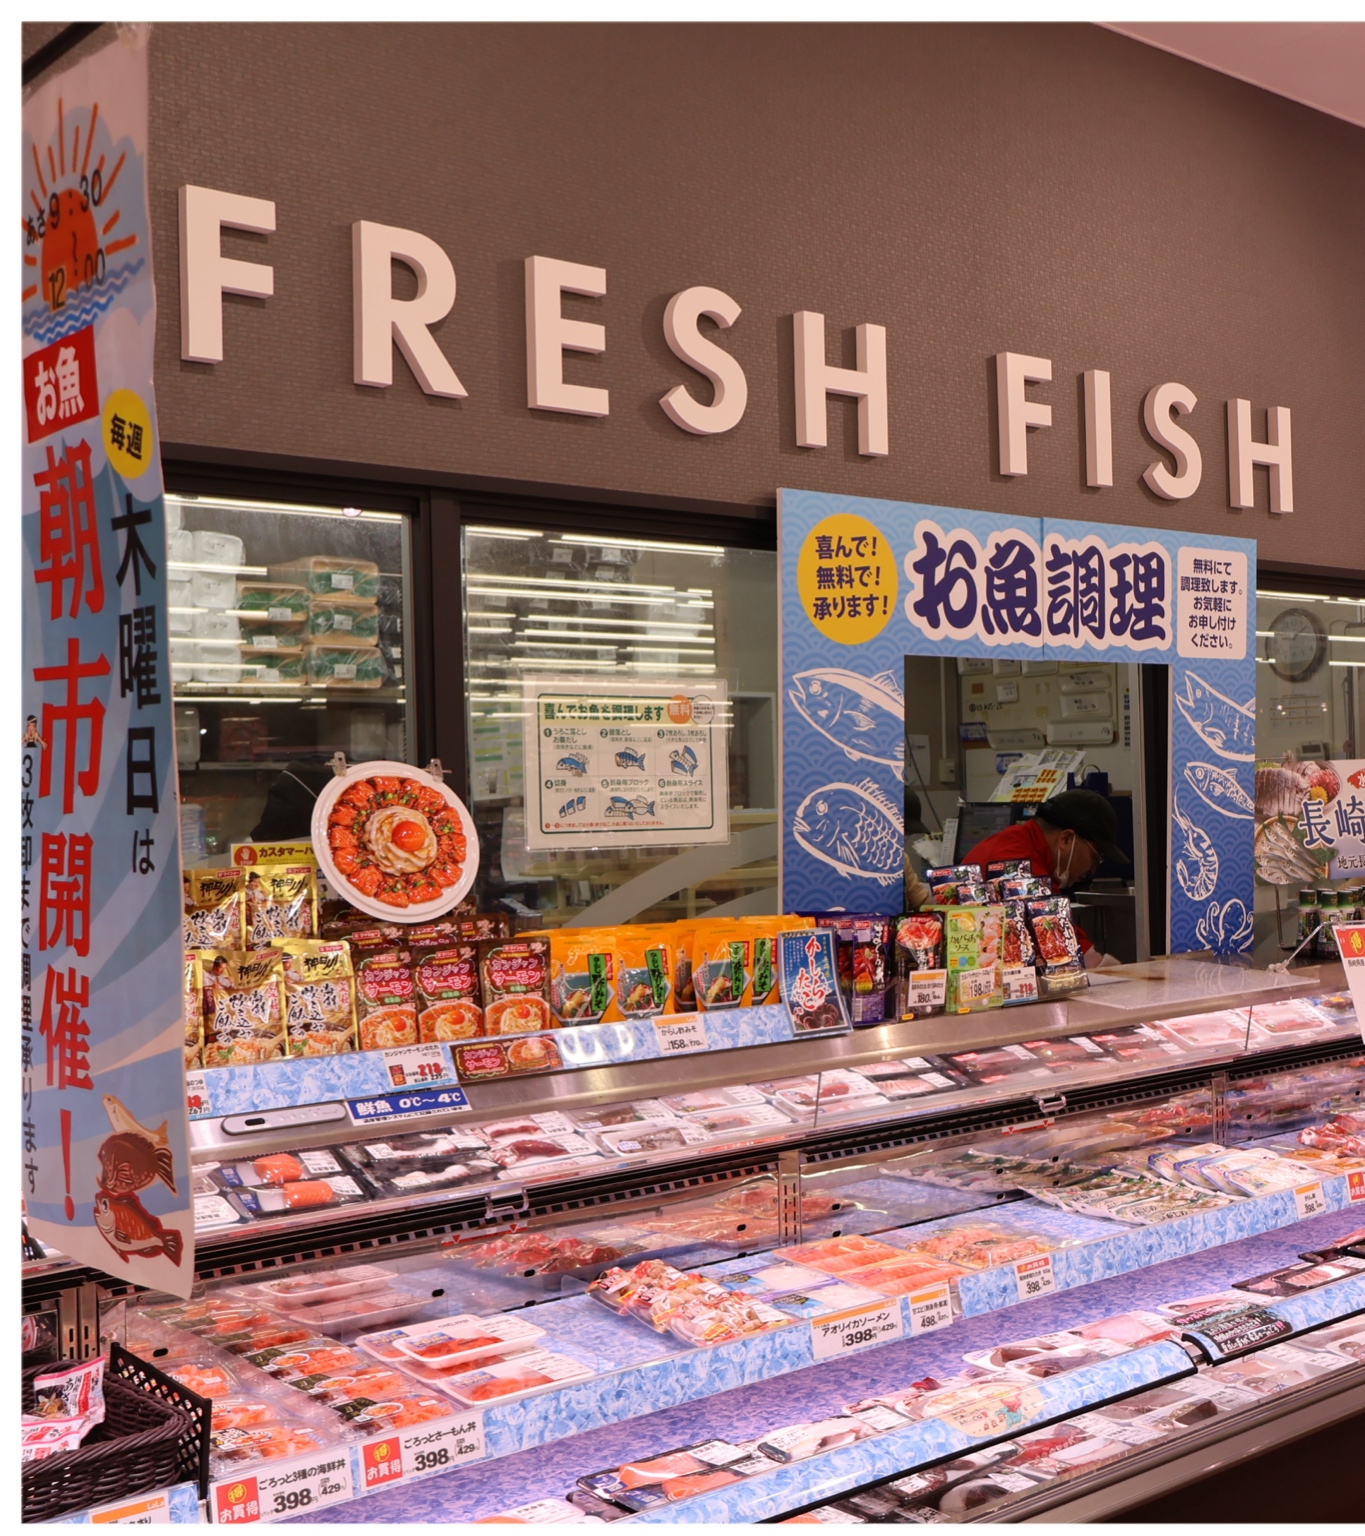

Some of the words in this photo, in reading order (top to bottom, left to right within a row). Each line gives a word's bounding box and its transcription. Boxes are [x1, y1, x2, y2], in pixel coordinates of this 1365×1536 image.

[178, 184, 889, 458] FRESH
[993, 350, 1294, 515] FISH
[34, 345, 86, 427] お魚
[110, 412, 144, 461] 毎週
[1192, 558, 1233, 576] 無料にて
[911, 530, 1167, 642] お魚調理
[1180, 575, 1245, 596] 調理致します。
[1193, 596, 1233, 613] お気軽に
[1188, 614, 1238, 632] お申し付け
[1190, 633, 1235, 650] ください。
[111, 493, 161, 875] 木曜日は
[668, 702, 693, 718] 無料
[421, 963, 471, 978] カンジャン
[491, 957, 540, 971] カンジャン
[422, 976, 473, 992] サーモン
[491, 970, 542, 986] サーモン
[365, 981, 414, 998] サーモン
[355, 1101, 394, 1117] 鮮魚
[821, 1311, 891, 1338] アオリイカソーメン
[403, 1420, 478, 1451] ごろっとさーもん丼
[258, 1457, 347, 1492] ごろっと3種の海鮮丼
[366, 1459, 403, 1482] お買得
[218, 1499, 260, 1525] お買得
